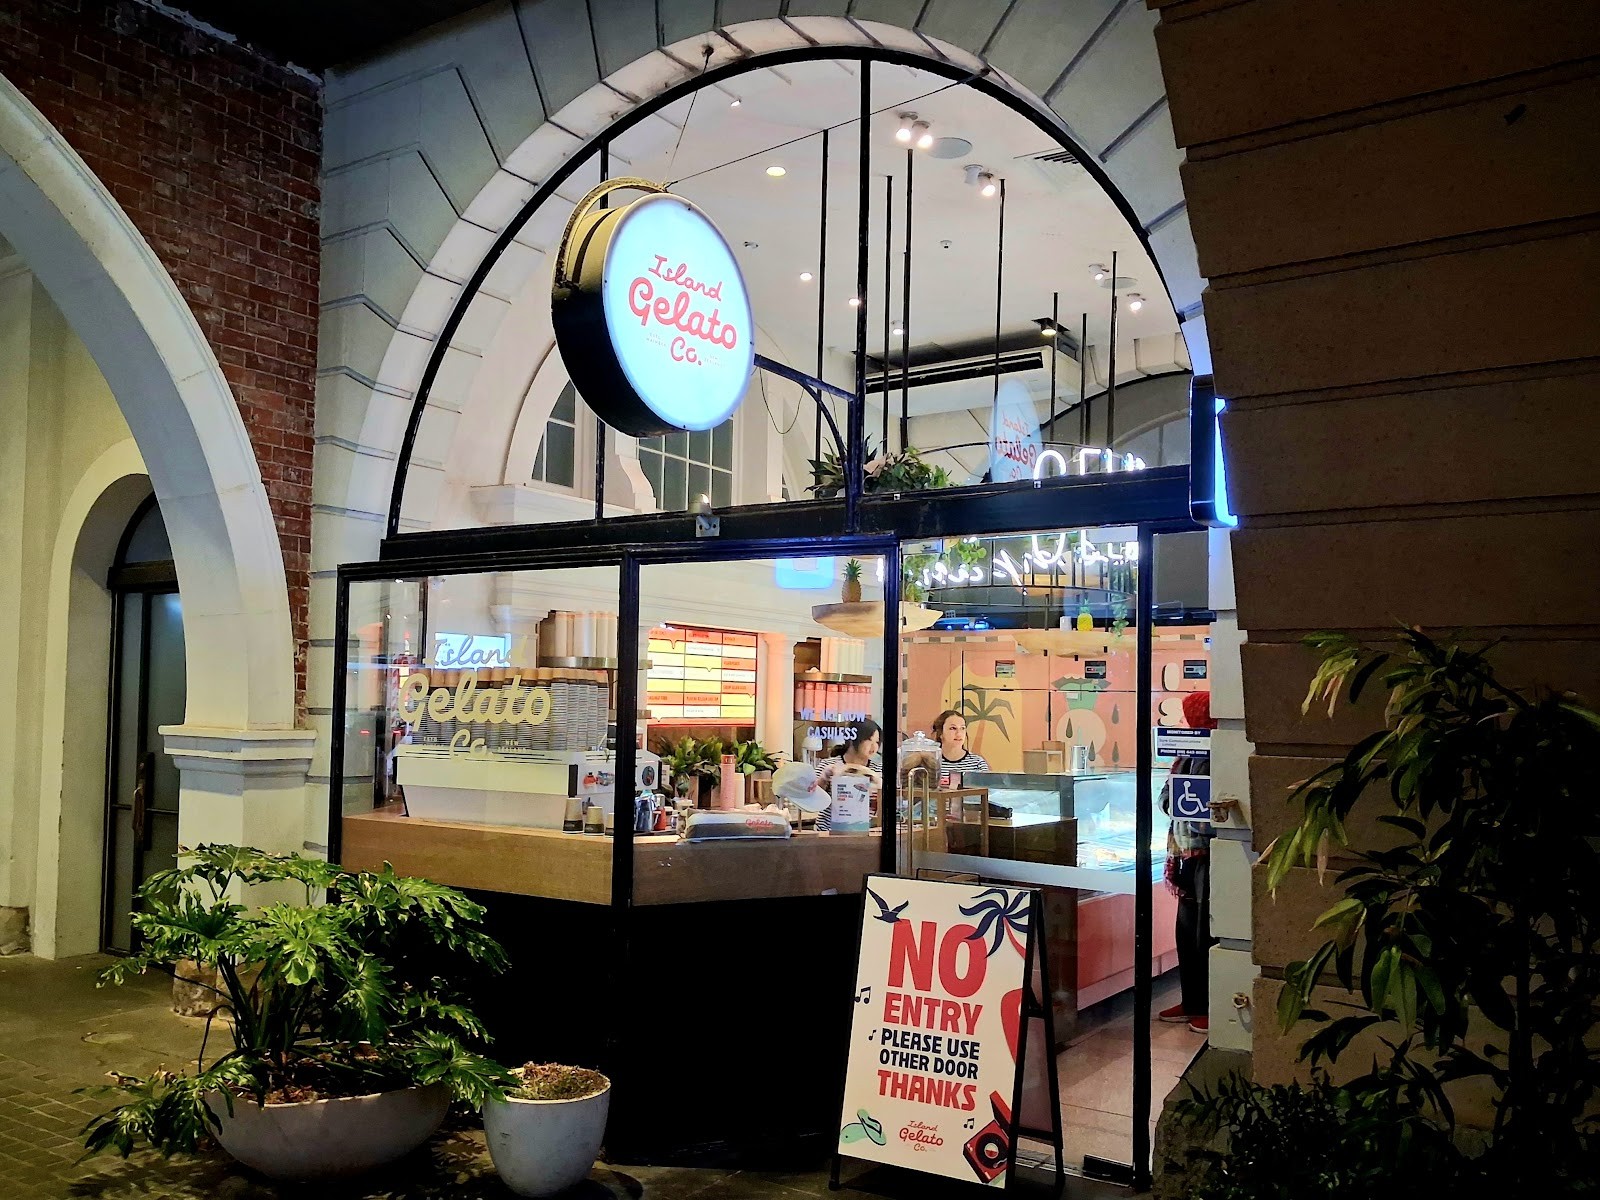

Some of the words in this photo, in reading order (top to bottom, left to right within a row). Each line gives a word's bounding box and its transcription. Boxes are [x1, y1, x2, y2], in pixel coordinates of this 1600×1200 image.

[648, 254, 722, 302] Island
[629, 277, 737, 350] Gelato
[670, 336, 702, 366] Co.
[423, 633, 528, 667] Island
[398, 669, 552, 732] Gelato
[807, 726, 858, 741] CASHLESS
[887, 919, 988, 998] NO
[883, 993, 983, 1036] ENTRY
[880, 1028, 943, 1054] PLEASE
[948, 1038, 980, 1060] USE
[879, 1048, 930, 1072] OTHER
[934, 1058, 979, 1080] DOOR
[878, 1069, 977, 1112] THANKS
[899, 1128, 944, 1146] Gelato
[908, 1120, 938, 1132] Island
[913, 1143, 928, 1152] Co.
